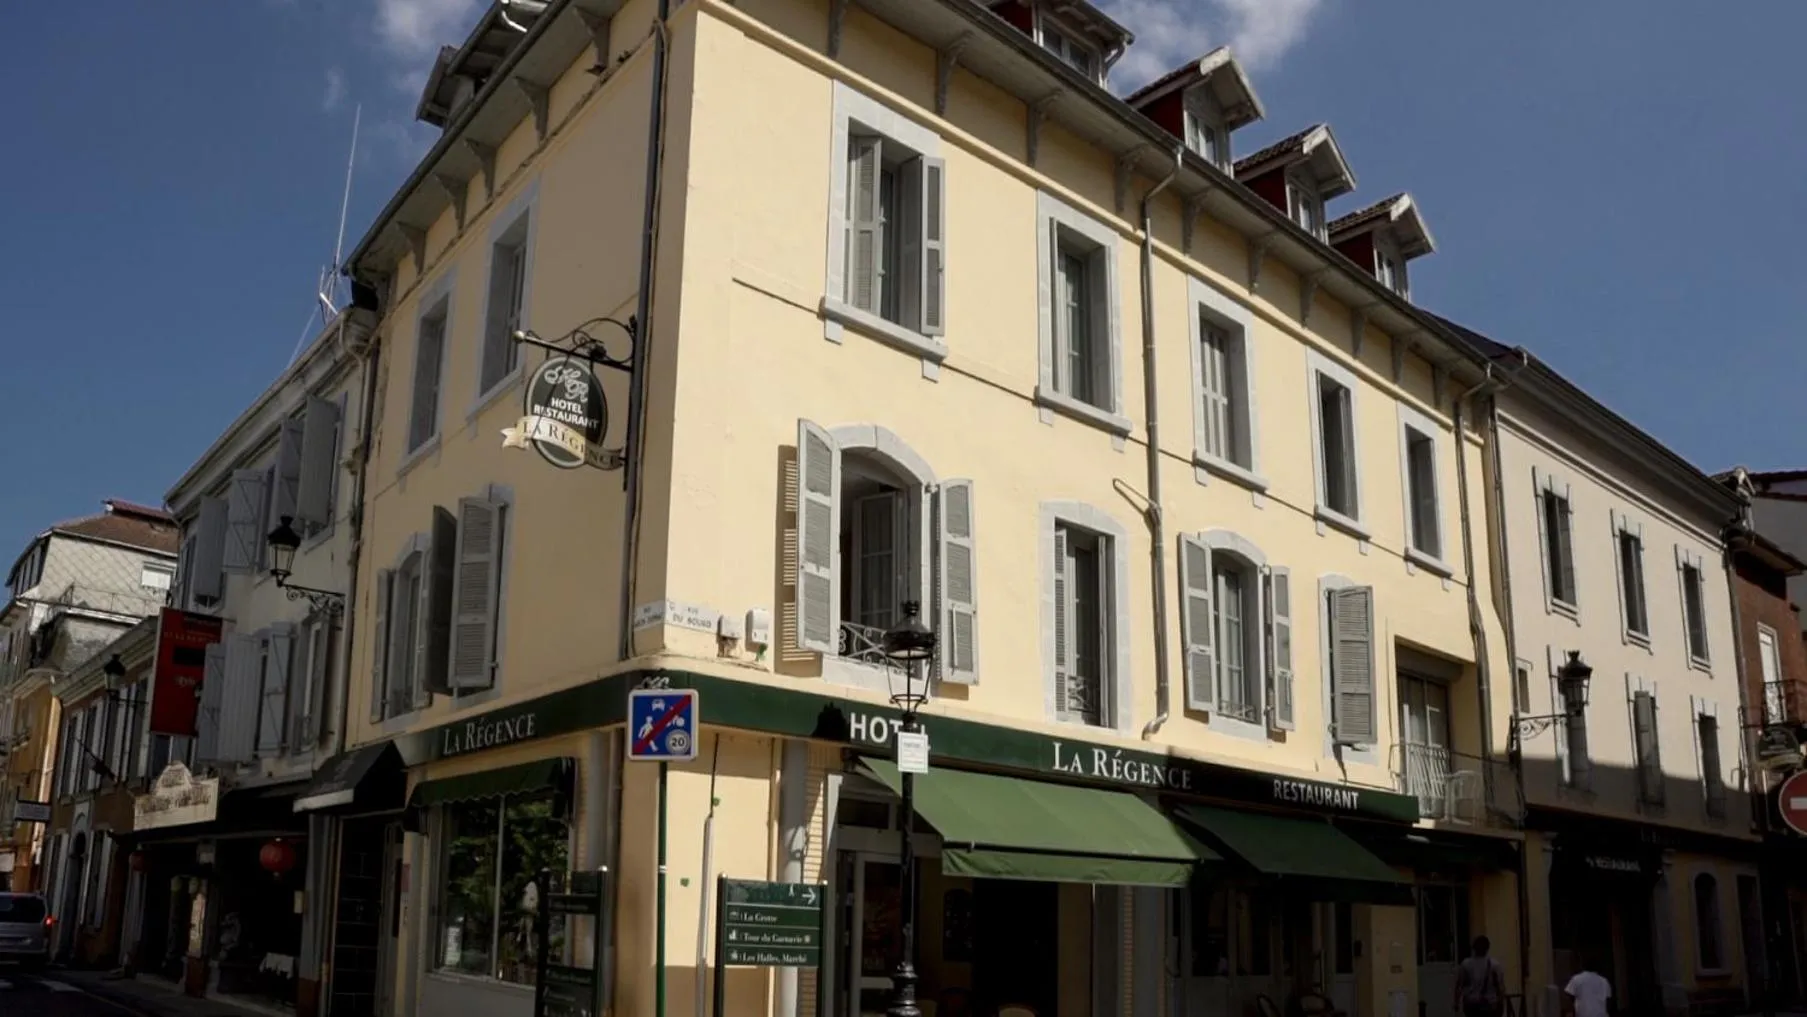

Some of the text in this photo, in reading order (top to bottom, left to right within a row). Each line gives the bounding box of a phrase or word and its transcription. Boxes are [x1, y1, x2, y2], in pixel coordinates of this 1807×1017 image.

[533, 404, 600, 429] RESTAURANT
[551, 397, 583, 413] HOTEL
[443, 713, 536, 757] LA RÉGENCE
[671, 737, 685, 748] 20
[1053, 741, 1192, 790] LA RÉGENCE
[1273, 779, 1359, 810] RESTAURANT
[743, 951, 756, 962] Les
